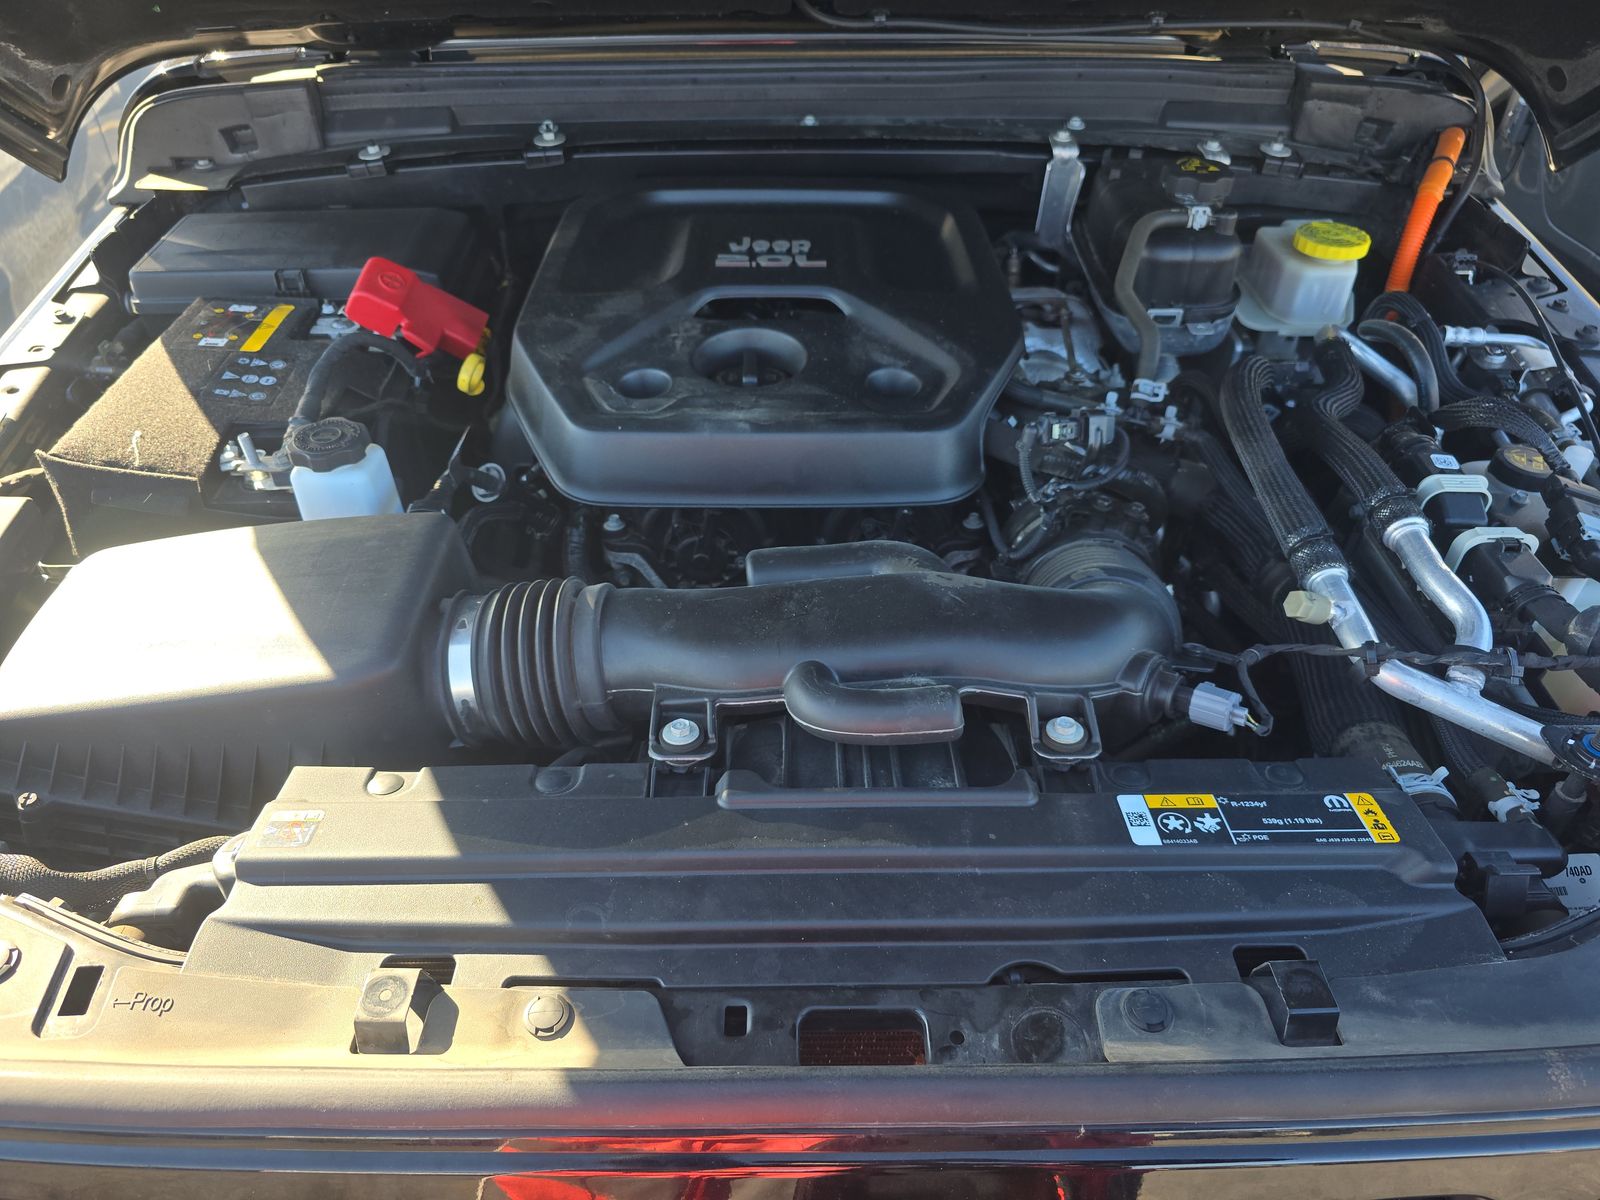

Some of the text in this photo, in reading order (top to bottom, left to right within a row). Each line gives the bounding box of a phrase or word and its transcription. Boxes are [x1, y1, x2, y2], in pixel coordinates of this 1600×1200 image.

[729, 236, 811, 253] Jeep
[715, 253, 828, 268] 2.0L
[1230, 800, 1268, 809] R-1234yf
[1252, 834, 1270, 842] POE
[130, 992, 174, 1017] Prop
